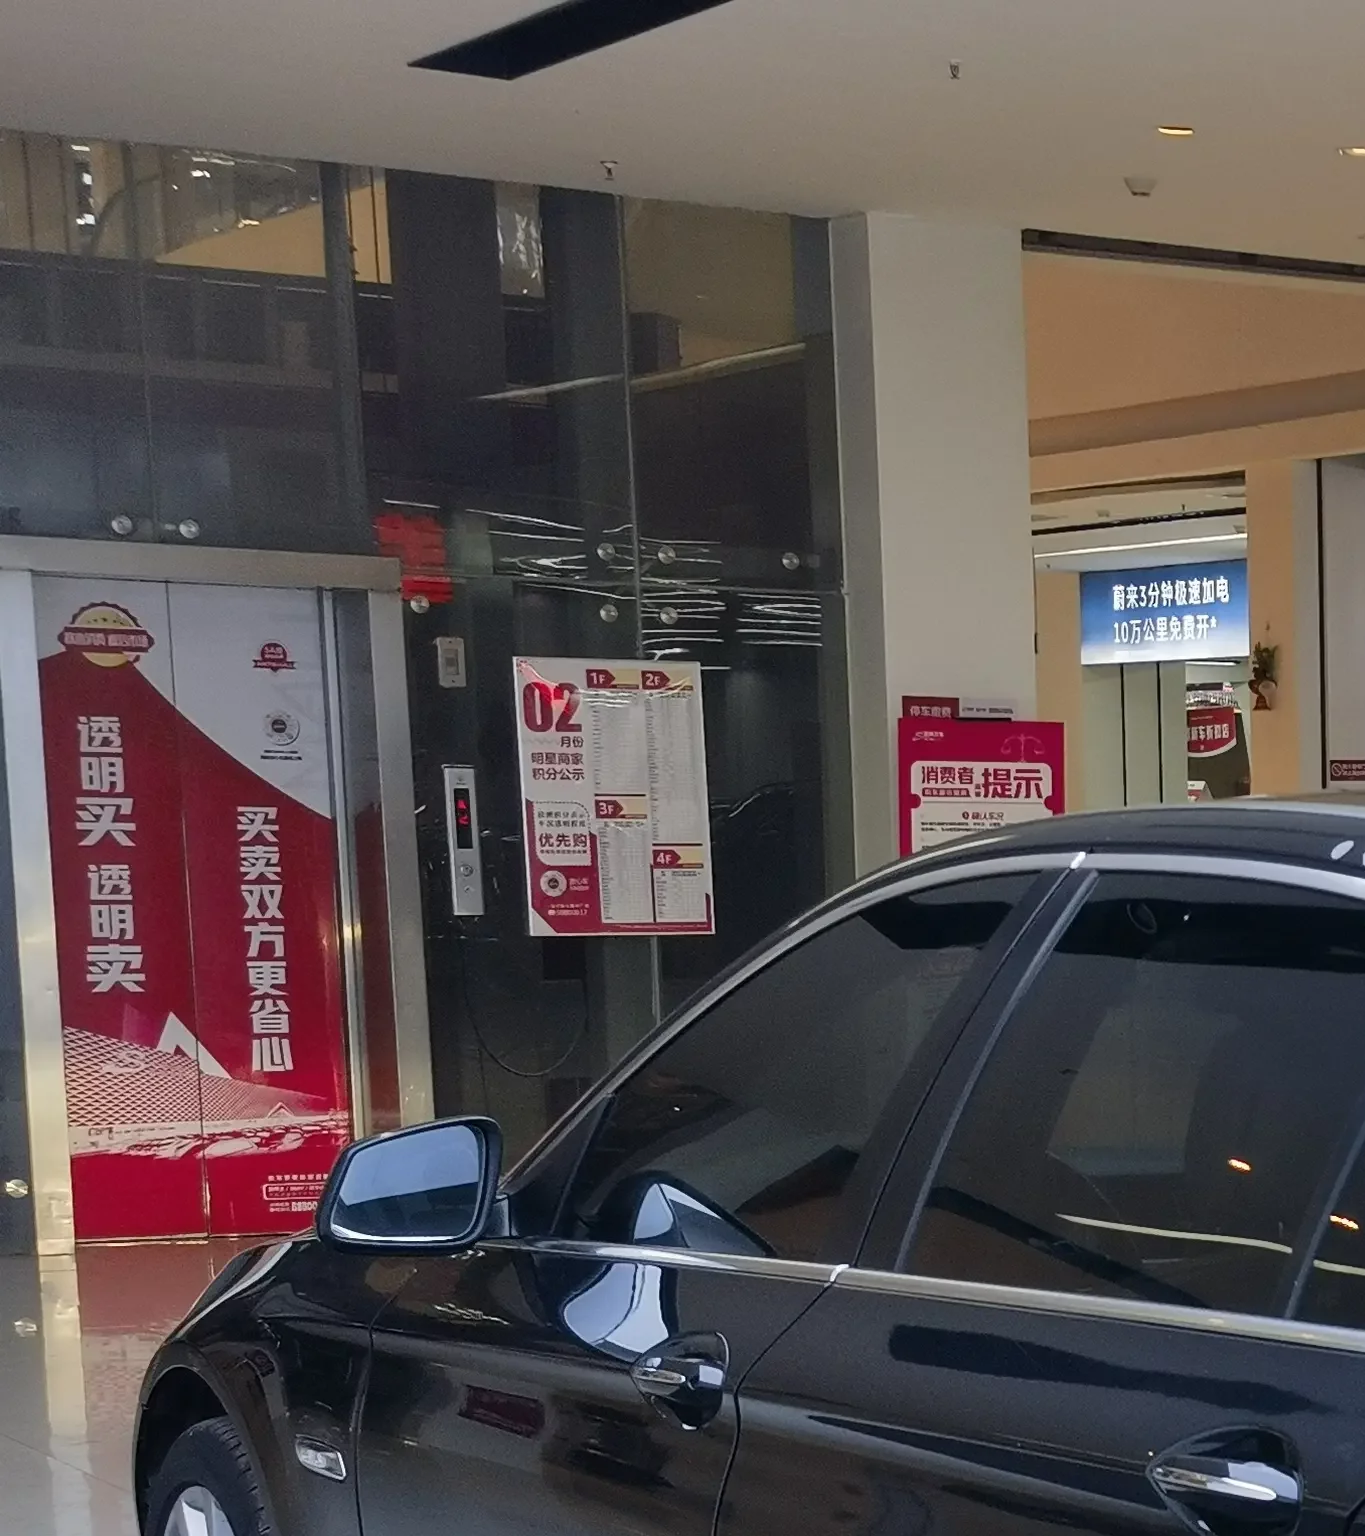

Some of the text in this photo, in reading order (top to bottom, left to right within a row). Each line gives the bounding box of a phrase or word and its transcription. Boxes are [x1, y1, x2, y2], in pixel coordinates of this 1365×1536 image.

[1112, 575, 1230, 611] 蔚来3分钟极速加电
[590, 672, 606, 684] 1F
[645, 673, 661, 686] 2F
[523, 682, 582, 733] 02
[560, 735, 585, 748] 月份
[531, 752, 585, 766] 明星商家
[532, 767, 585, 781] 积分公示
[921, 766, 974, 784] 消费者
[981, 767, 1043, 799] 提示
[599, 802, 615, 815] 3F
[539, 832, 588, 848] 优先购
[656, 852, 672, 864] 4F
[237, 806, 294, 1073] 买卖双方更省心
